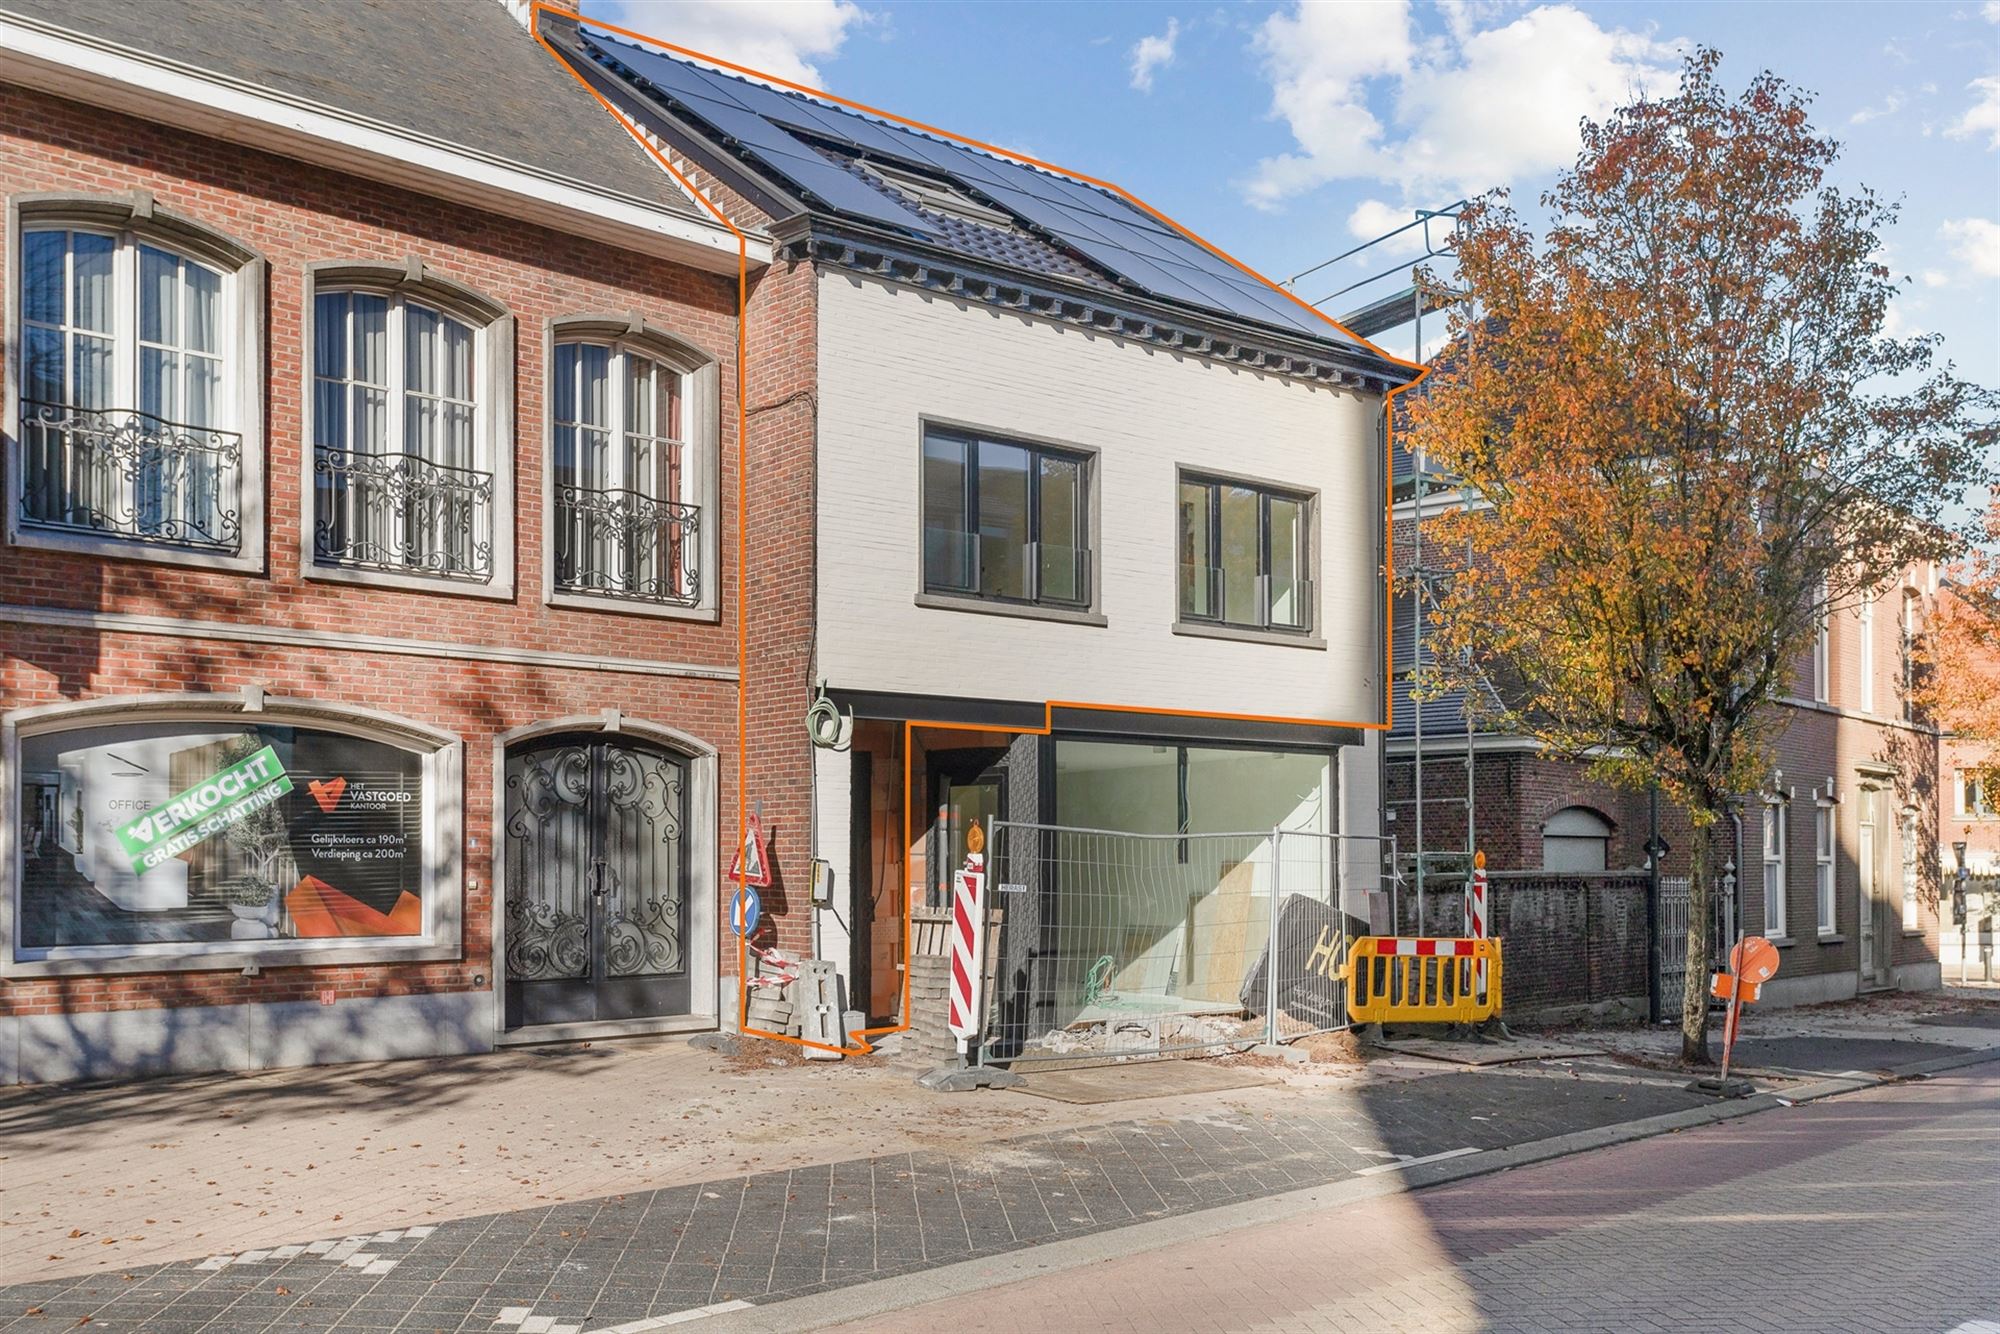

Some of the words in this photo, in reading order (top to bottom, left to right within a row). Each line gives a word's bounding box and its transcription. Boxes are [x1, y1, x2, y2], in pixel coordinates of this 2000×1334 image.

[127, 756, 269, 843] VERKOCHT
[350, 791, 412, 802] VASTGOED
[108, 800, 151, 811] OFFICE
[350, 802, 387, 810] KANTOOR
[143, 830, 199, 869] GRATIS
[198, 784, 282, 837] SCHATTING
[311, 833, 364, 847] Gelijkvloers
[311, 848, 362, 861] Verdieping
